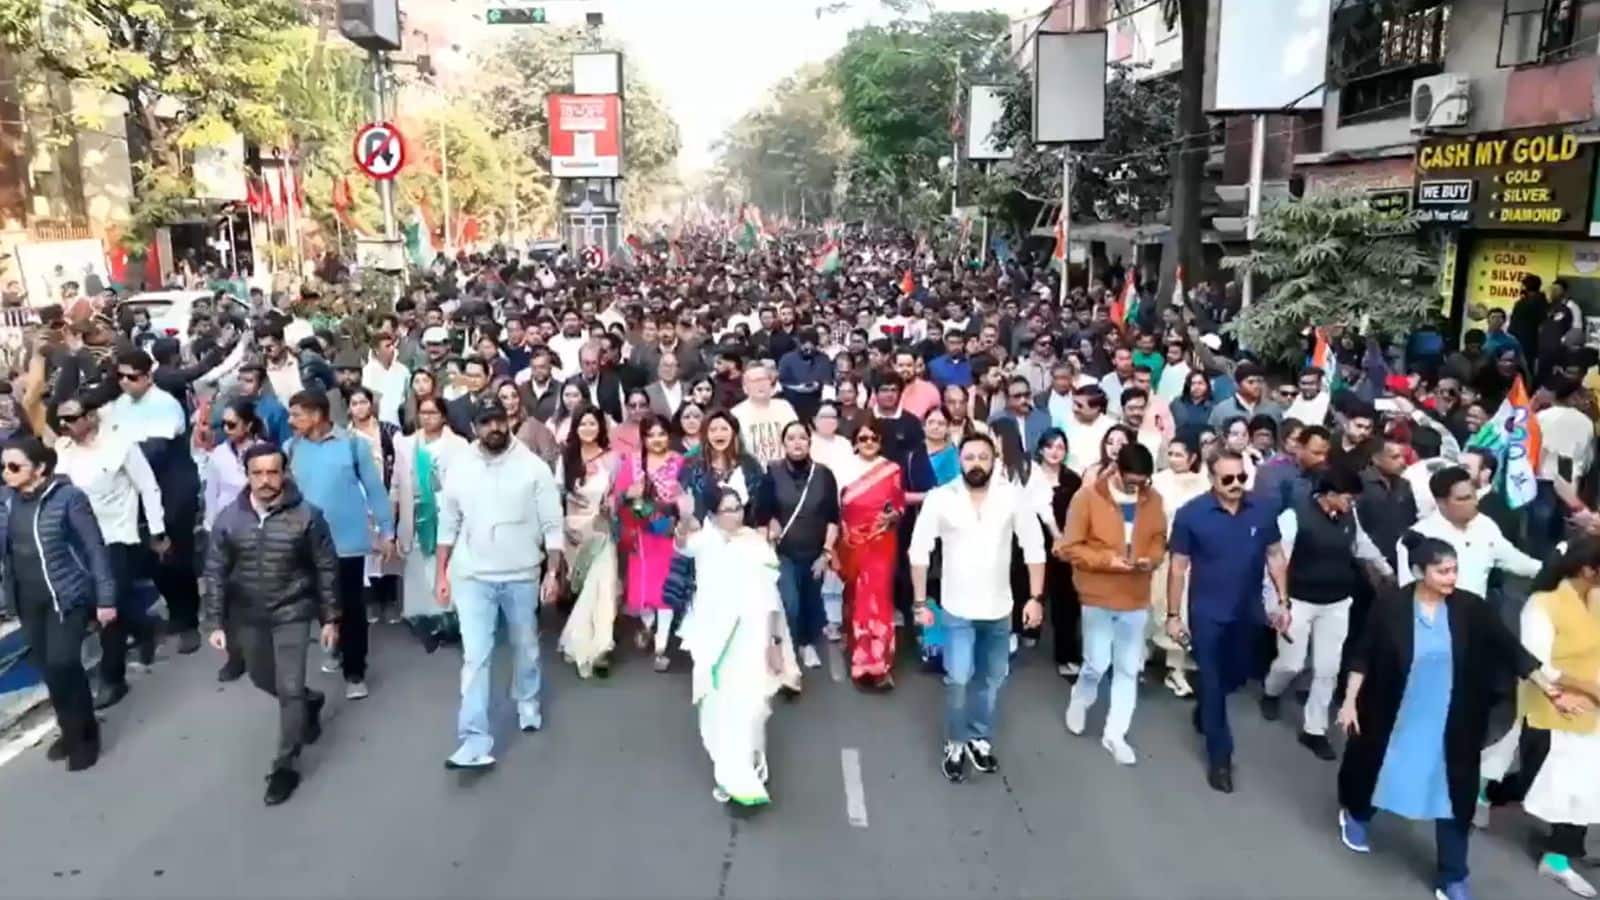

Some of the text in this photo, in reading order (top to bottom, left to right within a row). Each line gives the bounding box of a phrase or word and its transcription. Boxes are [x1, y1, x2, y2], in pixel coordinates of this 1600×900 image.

[1419, 134, 1578, 169] CASH MY GOLD
[1505, 169, 1542, 184] GOLD
[1424, 184, 1468, 199] WE BUY
[1503, 187, 1550, 203] SILVER
[1500, 207, 1562, 223] DIAMOND
[1494, 253, 1526, 266] GOLD
[1490, 270, 1526, 282] SILVE
